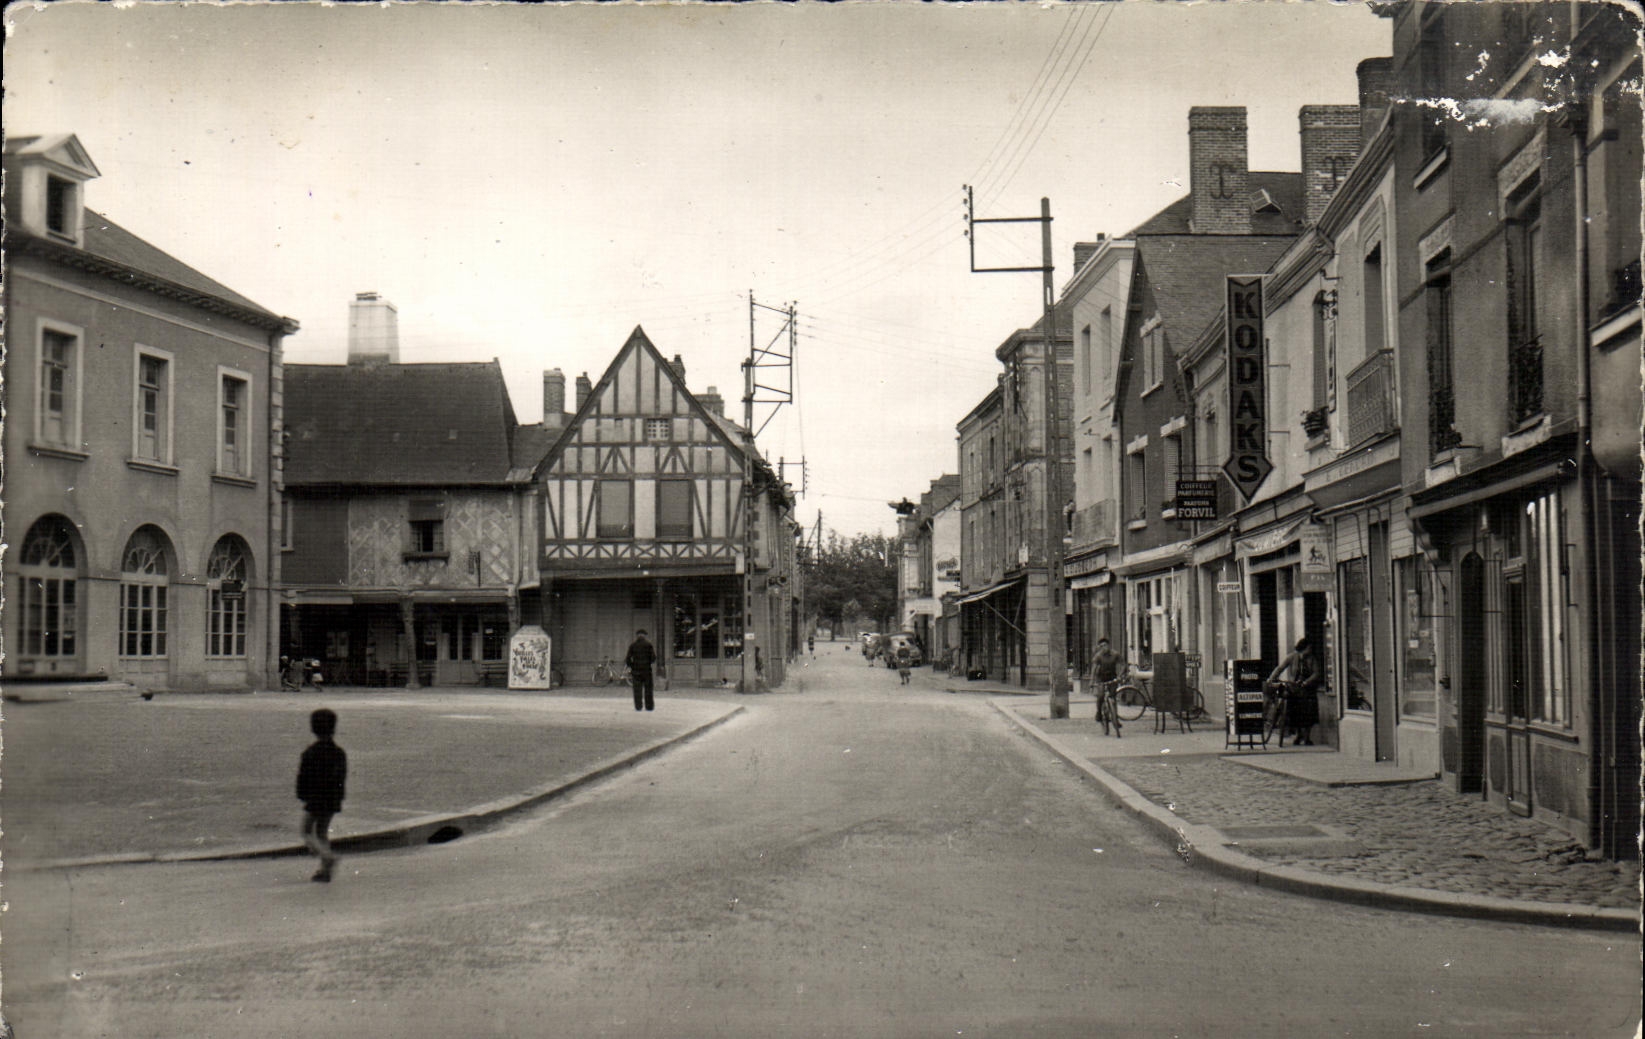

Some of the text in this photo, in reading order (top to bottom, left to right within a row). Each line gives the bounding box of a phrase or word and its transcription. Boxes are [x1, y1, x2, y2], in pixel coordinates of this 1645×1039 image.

[1234, 291, 1261, 483] KODAKS
[1178, 507, 1216, 518] FORVIL
[1240, 673, 1259, 681] PHOTO
